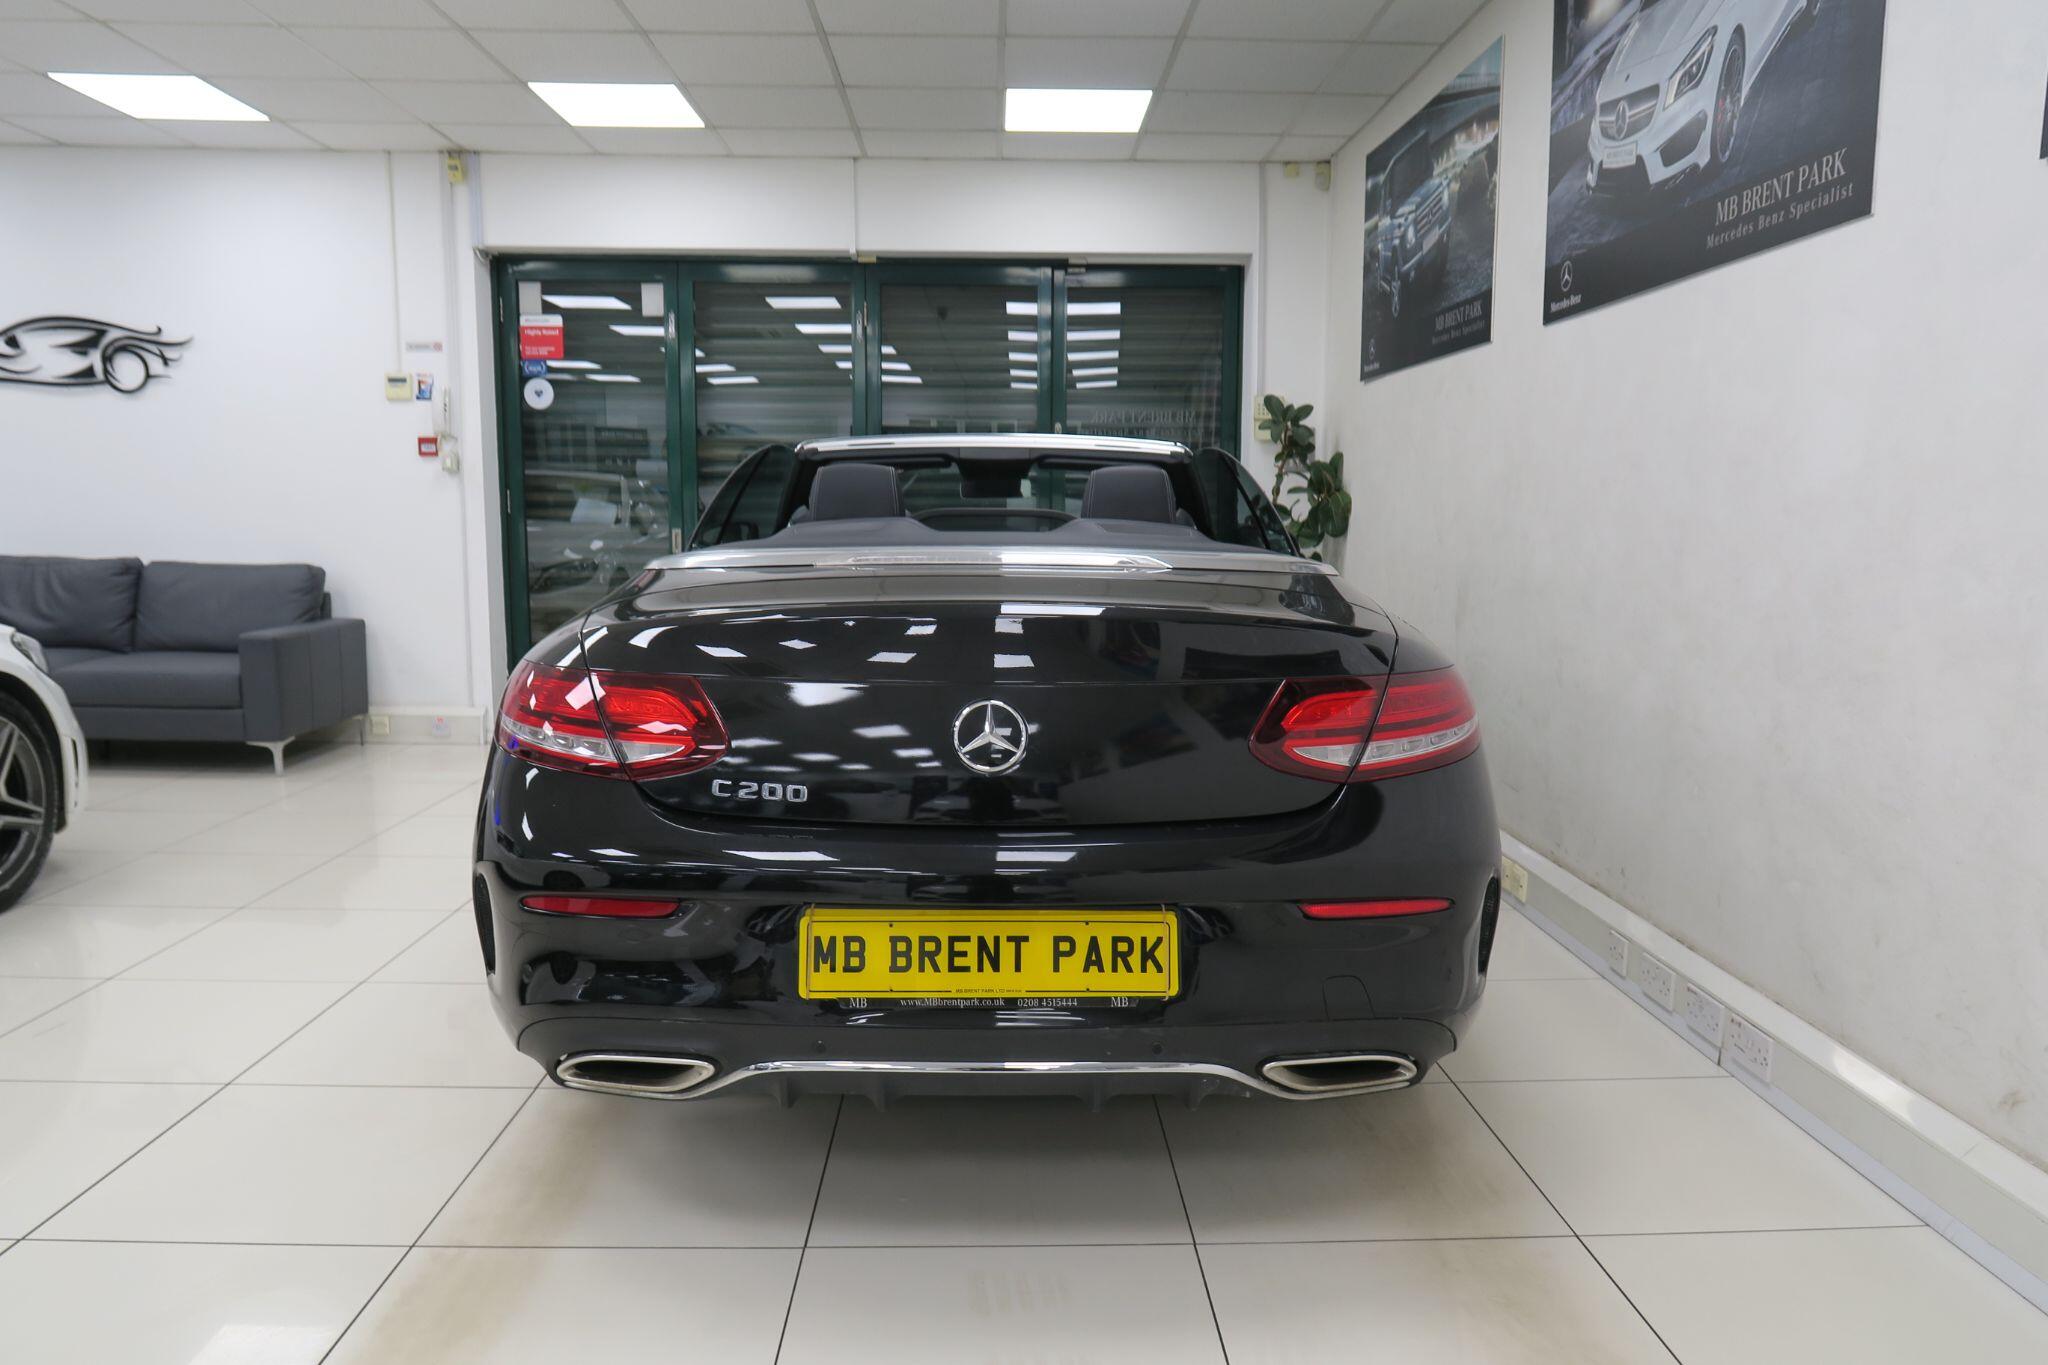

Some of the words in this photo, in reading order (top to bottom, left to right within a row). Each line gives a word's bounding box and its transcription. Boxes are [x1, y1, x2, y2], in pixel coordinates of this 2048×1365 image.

[1715, 195, 1738, 226] MB
[1742, 170, 1794, 216] BRENT
[1797, 147, 1848, 193] PARK
[1706, 219, 1754, 249] Mercedes
[1758, 210, 1785, 232] Benz
[1788, 183, 1854, 220] Specialist
[1445, 306, 1464, 329] BRENT
[1464, 300, 1482, 321] PARK
[813, 935, 867, 974] MB
[889, 935, 1030, 974] BRENT
[1052, 935, 1165, 974] PARK
[849, 996, 868, 1009] MB
[900, 997, 1006, 1009] www.MBbrentpark.co.uk
[1017, 998, 1040, 1008] 0208
[1041, 998, 1078, 1008] 4515444
[1110, 996, 1130, 1008] MB
